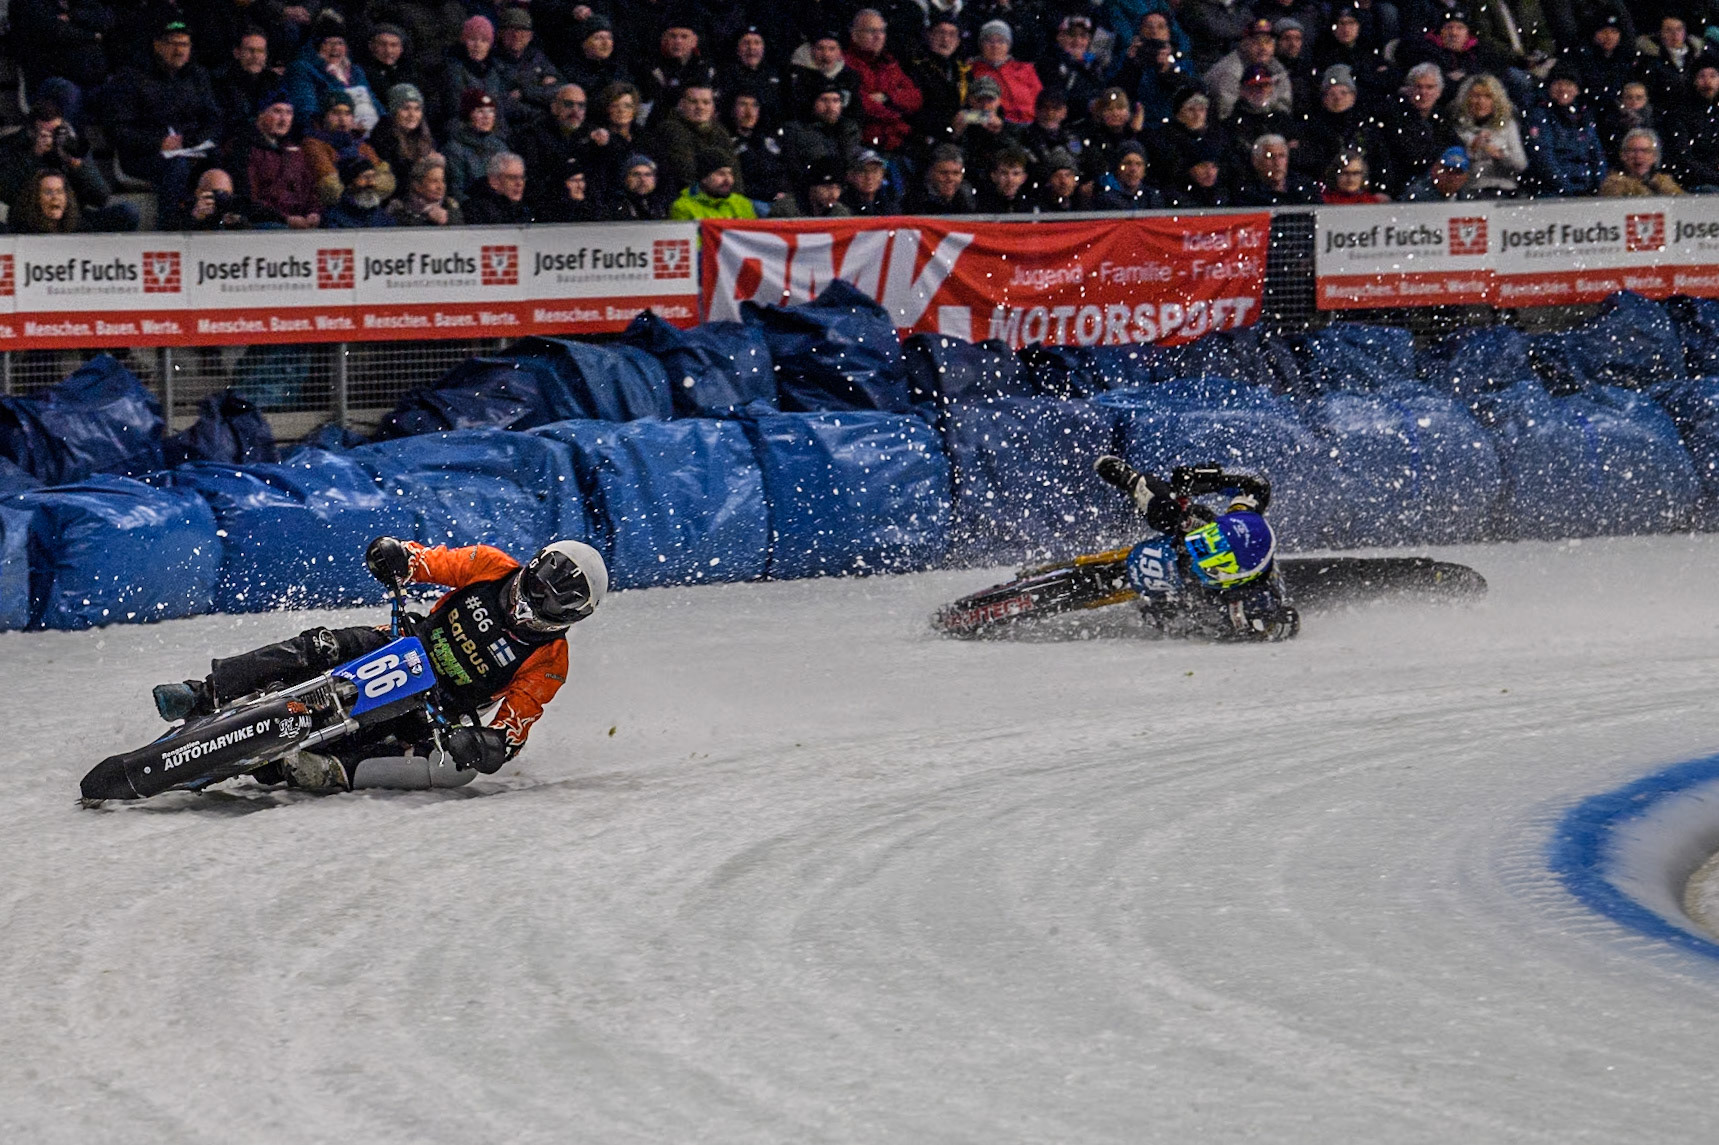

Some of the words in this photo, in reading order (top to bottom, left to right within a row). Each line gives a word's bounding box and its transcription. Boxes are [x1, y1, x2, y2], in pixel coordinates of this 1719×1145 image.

[1325, 225, 1379, 253] Josef
[1384, 224, 1443, 246] Fuchs
[1501, 223, 1555, 252] Josef
[1561, 222, 1620, 243] Fuchs
[1673, 220, 1719, 244] Jose
[24, 258, 77, 287] Josef
[81, 257, 138, 282] Fuchs
[197, 256, 251, 285] Josef
[256, 255, 312, 278] Fuchs
[364, 252, 416, 281] Josef
[421, 252, 476, 274] Fuchs
[534, 248, 587, 276] Josef
[592, 247, 648, 269] Fuchs
[1010, 264, 1083, 290] Jugend
[1101, 261, 1172, 283] Familie
[464, 595, 494, 633] #66
[356, 653, 408, 699] 66
[164, 724, 254, 771] AUTOTARVIKE
[256, 718, 271, 736] OY
